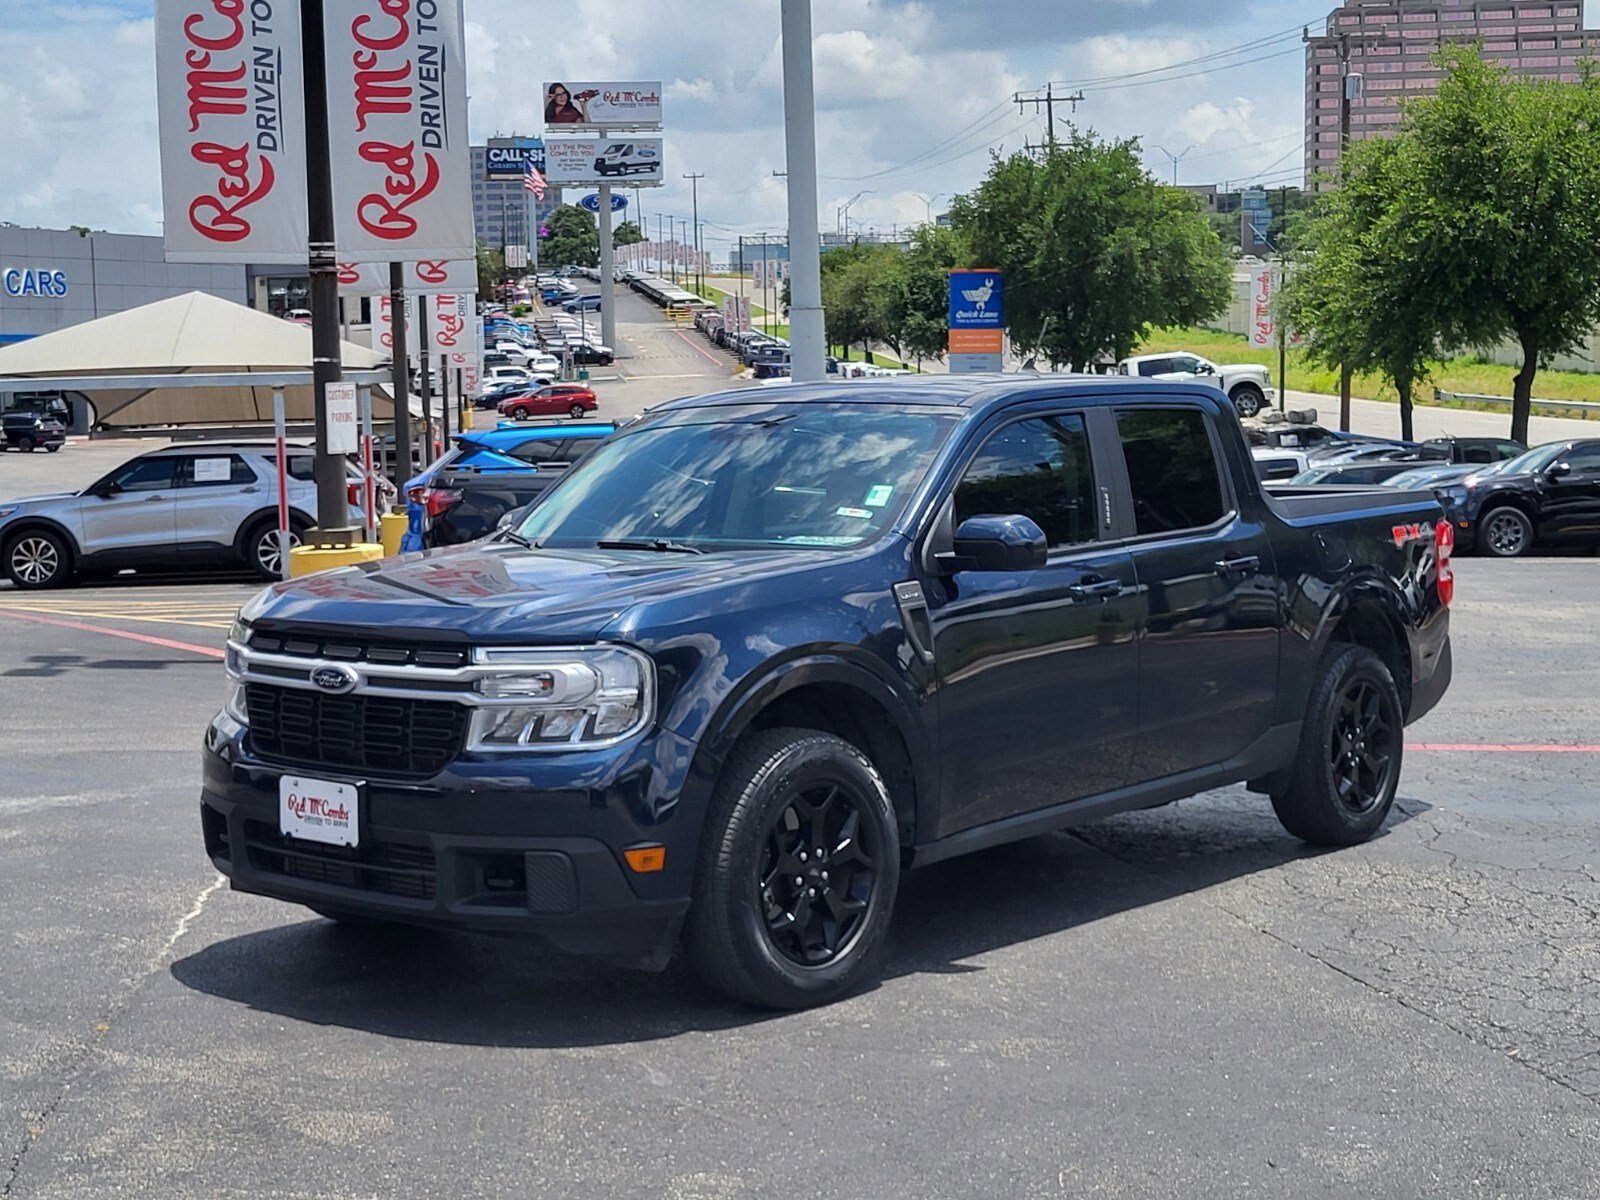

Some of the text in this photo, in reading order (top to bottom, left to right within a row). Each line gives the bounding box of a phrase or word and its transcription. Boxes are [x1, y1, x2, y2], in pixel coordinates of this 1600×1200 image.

[250, 0, 278, 152] DRIVEN TO
[415, 0, 442, 149] DRIVEN TO
[603, 91, 620, 106] Red
[621, 91, 660, 103] McCombs
[189, 142, 275, 242] Red
[357, 140, 440, 240] Red
[5, 268, 67, 297] CARS
[955, 310, 999, 319] Quick Lane
[436, 314, 464, 347] Red
[331, 412, 354, 422] PARKING
[1392, 522, 1434, 548] FX4
[319, 674, 343, 687] Ford
[288, 793, 349, 820] Red McCombs
[304, 815, 323, 824] DRIVEN
[333, 820, 348, 828] SERVE
